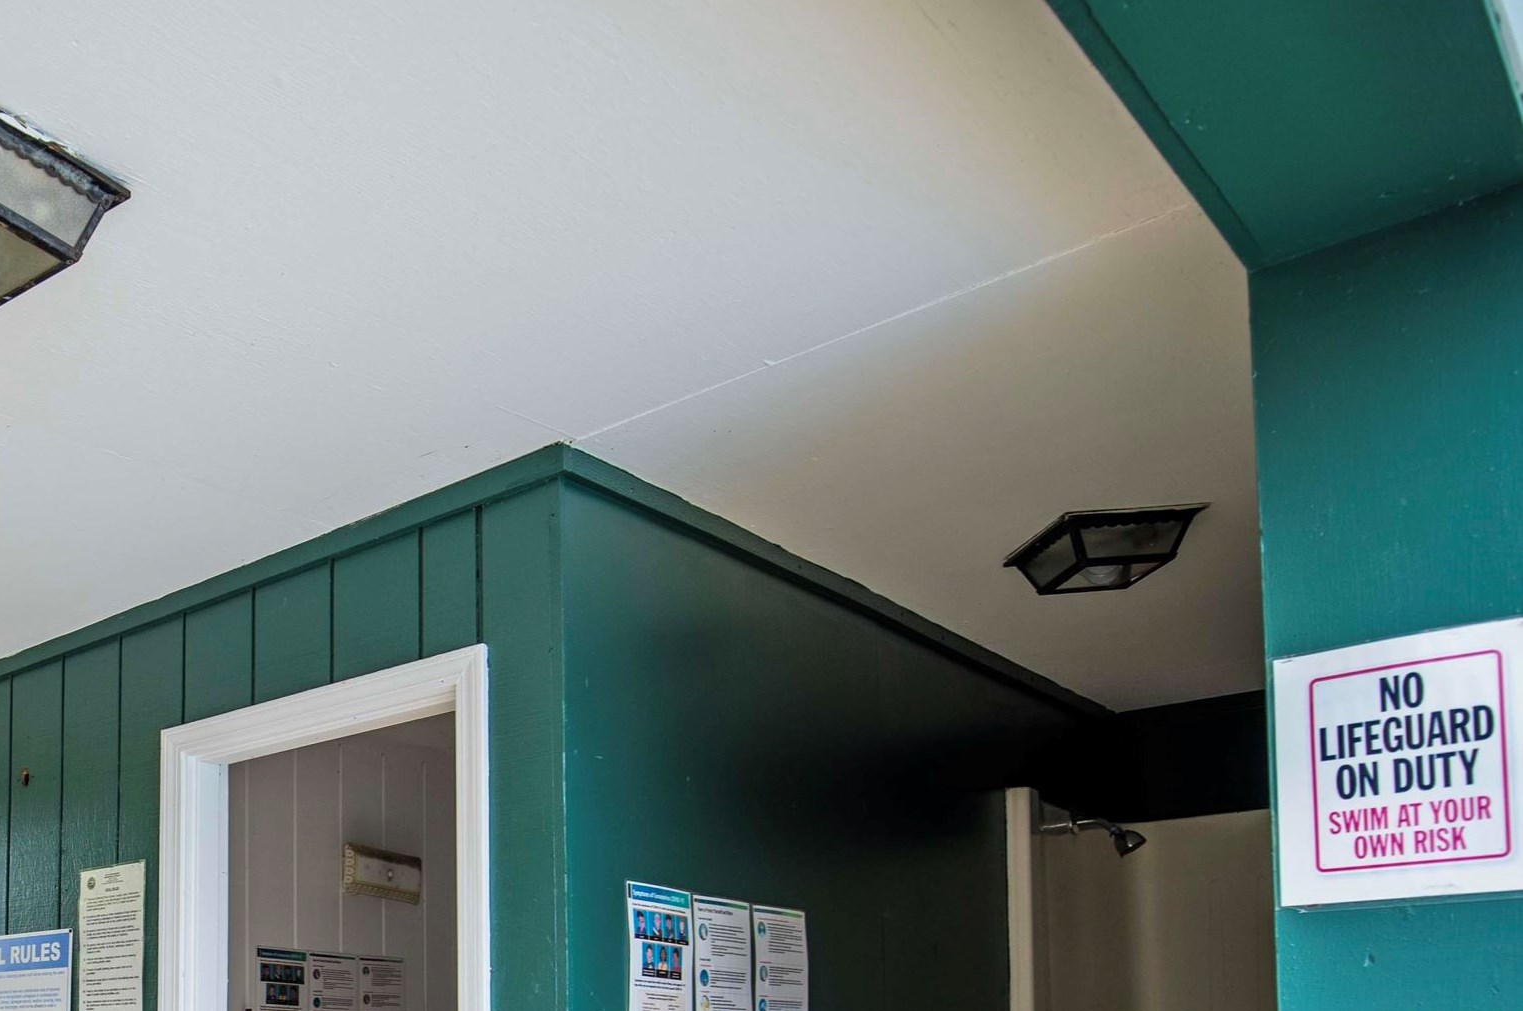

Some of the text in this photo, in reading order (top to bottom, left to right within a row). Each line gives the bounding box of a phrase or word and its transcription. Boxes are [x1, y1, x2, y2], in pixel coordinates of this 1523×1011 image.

[1379, 672, 1424, 712] NO
[1319, 705, 1494, 761] LIFEGUARD
[1336, 748, 1479, 800] ON DUTY
[1328, 795, 1492, 835] SWIM AT YOUR
[1353, 826, 1467, 859] OWN RISK
[10, 941, 61, 965] RULES
